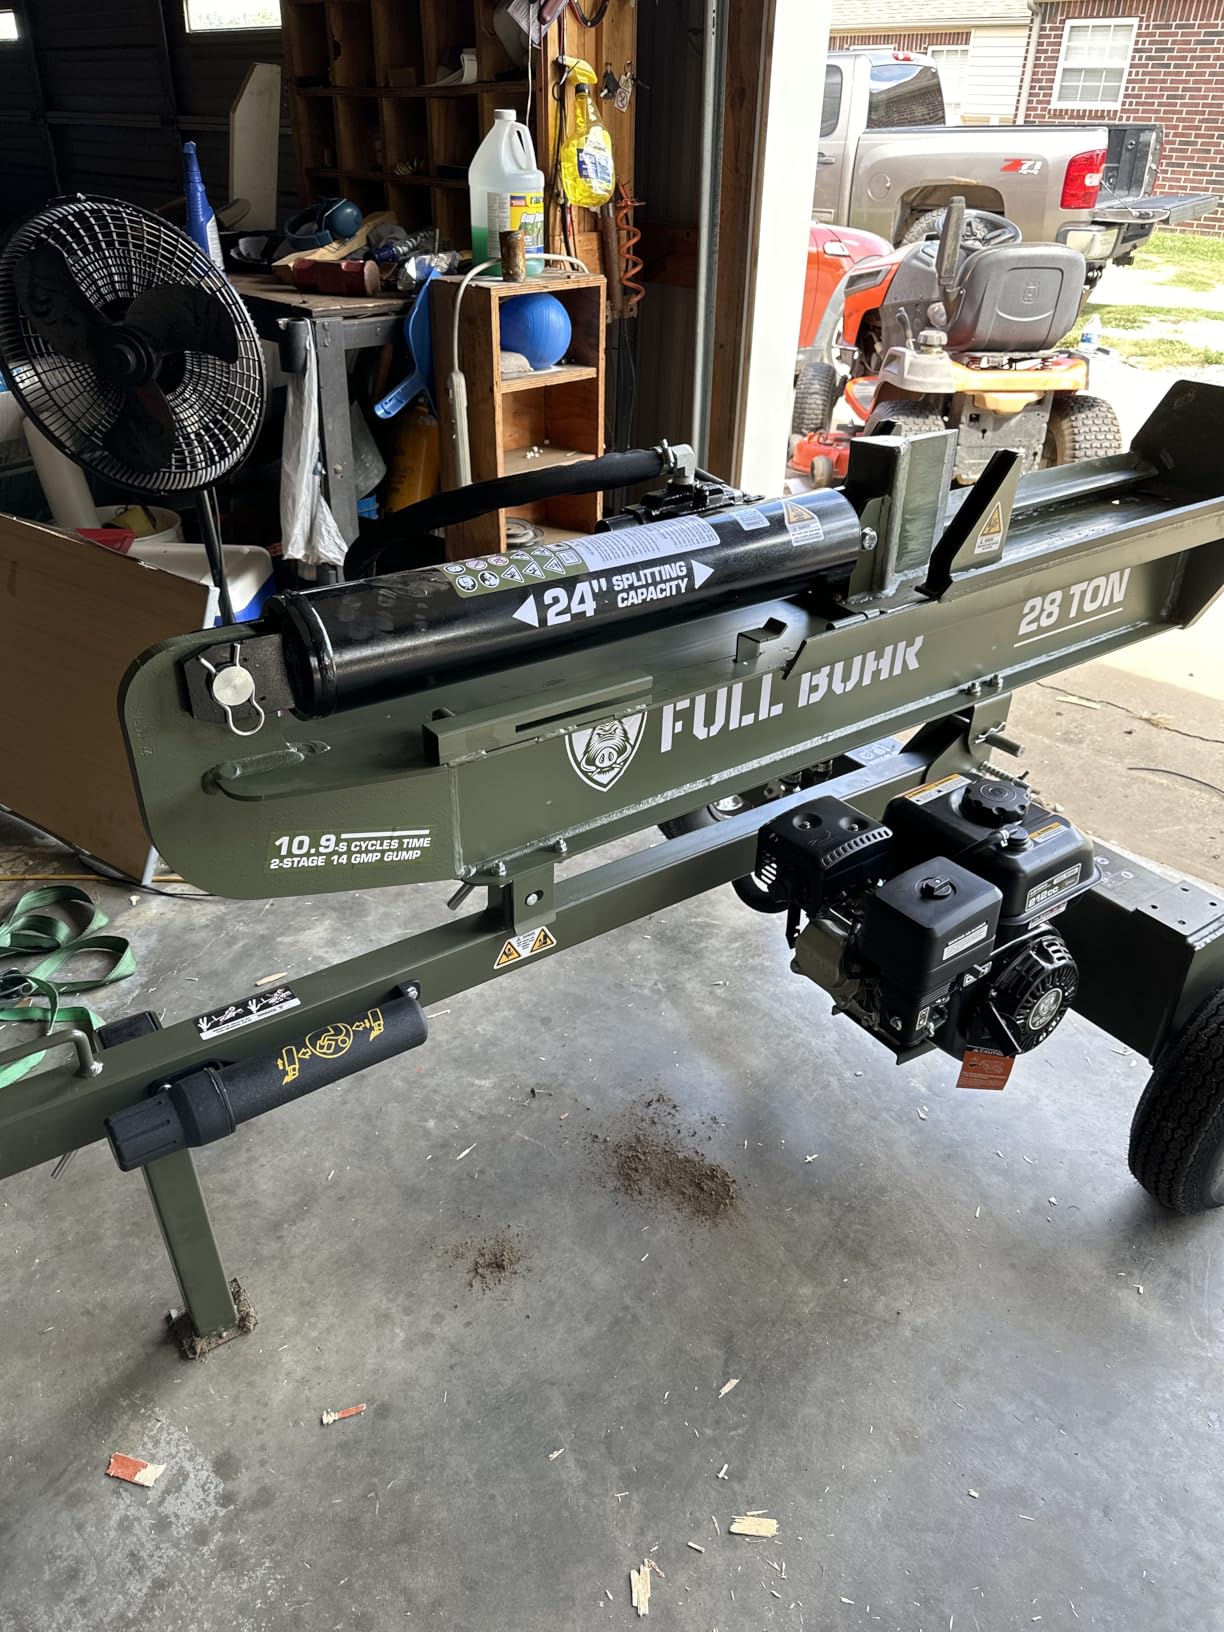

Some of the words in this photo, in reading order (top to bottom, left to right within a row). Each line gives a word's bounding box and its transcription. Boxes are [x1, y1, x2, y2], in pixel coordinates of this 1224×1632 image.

[1000, 158, 1042, 172] Z71
[612, 561, 687, 591] SPLITTING
[544, 578, 607, 626] 24"
[617, 578, 688, 608] CAPACITY
[1018, 590, 1062, 635] 28
[1069, 568, 1131, 618] TON
[661, 673, 783, 753] FULL
[351, 839, 399, 851] CYCLES
[402, 837, 431, 848] TIME
[270, 855, 326, 869] 2-STAGE
[331, 854, 347, 865] 14
[351, 852, 381, 864] GMP
[384, 850, 421, 862] GUMP
